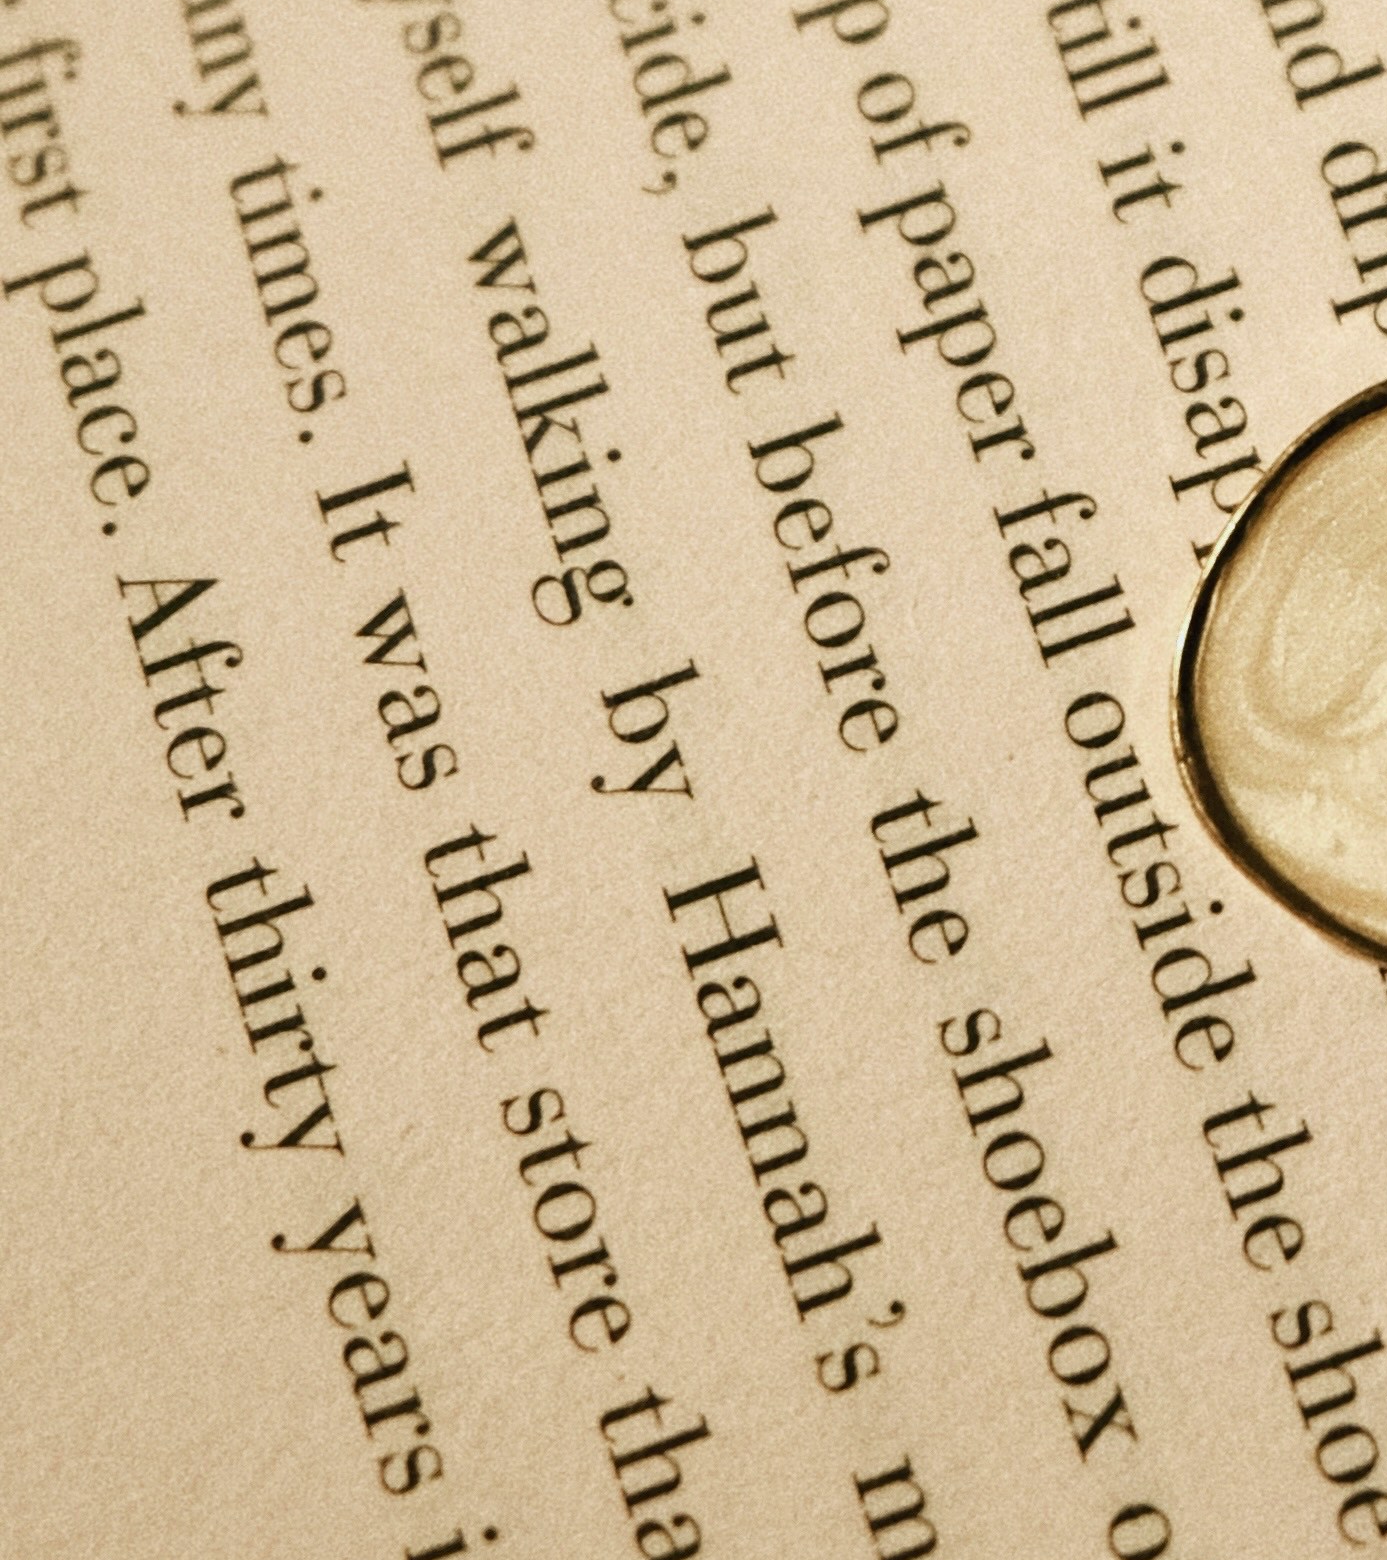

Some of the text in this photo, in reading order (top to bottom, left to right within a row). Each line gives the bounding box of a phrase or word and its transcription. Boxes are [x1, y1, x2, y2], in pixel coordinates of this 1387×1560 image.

[0, 37, 87, 225] first
[856, 71, 971, 163] of
[1097, 140, 1186, 222] it
[0, 253, 152, 538] place.
[228, 157, 348, 446] times.
[856, 183, 1037, 462] paper
[1129, 249, 1282, 572] disap
[316, 461, 416, 563] It
[992, 490, 1136, 667] fall
[115, 576, 247, 821] After
[354, 589, 460, 792] was
[467, 218, 636, 628] walking
[589, 658, 701, 800] by
[662, 856, 907, 1395] Hannah’s
[422, 824, 549, 1051] that
[681, 207, 795, 395] but
[747, 413, 900, 753] before
[868, 789, 981, 965] the
[937, 1007, 1139, 1462] shoebox
[1063, 690, 1258, 1072] outside
[204, 857, 346, 1157] thirty
[500, 1087, 632, 1352] store
[1201, 1092, 1314, 1271] the
[269, 1197, 444, 1497] years
